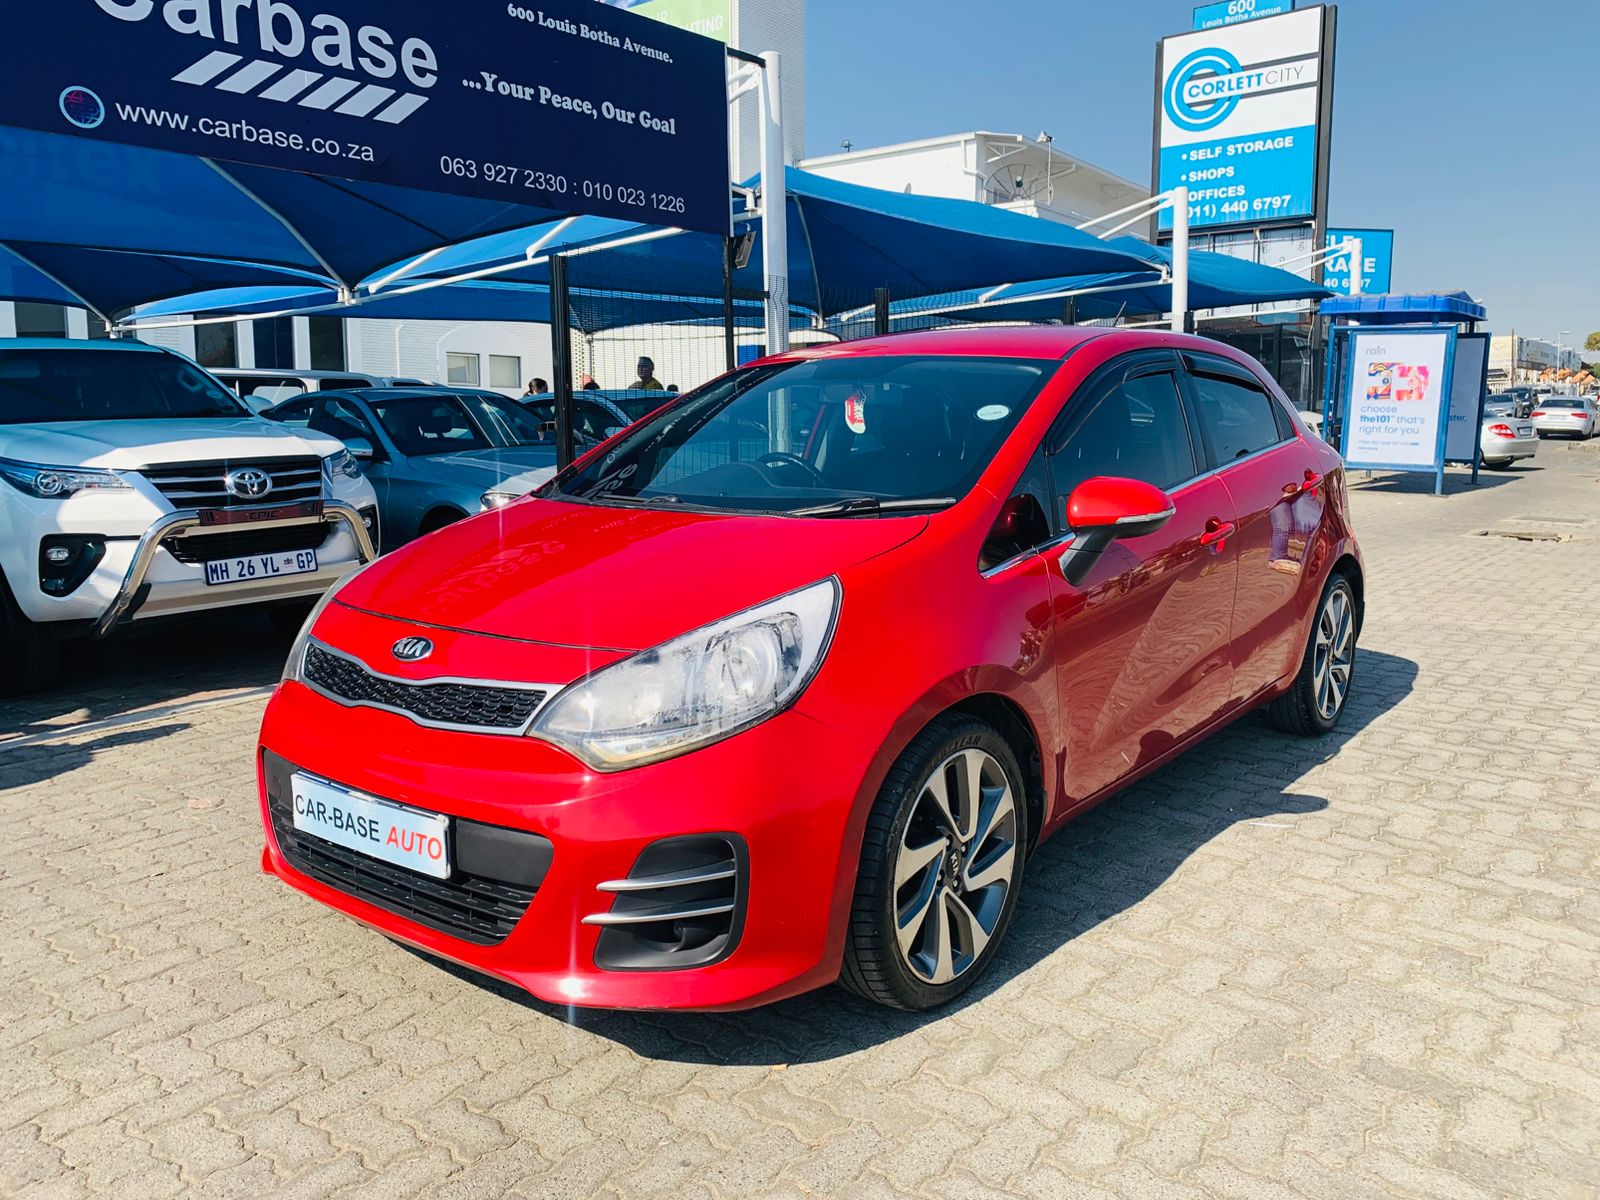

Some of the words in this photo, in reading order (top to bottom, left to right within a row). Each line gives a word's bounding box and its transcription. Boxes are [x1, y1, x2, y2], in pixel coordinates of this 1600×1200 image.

[1202, 18, 1223, 28] Louis
[1224, 13, 1248, 23] Botha
[1250, 6, 1282, 18] Avenue
[1227, 0, 1255, 15] 600
[94, 0, 438, 88] arbase
[507, 3, 535, 22] 600
[538, 11, 577, 35] Louis
[580, 24, 620, 48] Botha
[623, 37, 674, 63] Avenue.
[538, 85, 598, 119] Peace,
[602, 101, 636, 125] Our
[639, 110, 676, 135] Goal
[115, 102, 375, 162] www.carbase.co.za
[1189, 146, 1222, 161] SELF
[1226, 136, 1294, 156] STORAGE
[440, 155, 477, 179] 063
[484, 163, 518, 184] 927
[524, 170, 567, 193] 2330
[583, 180, 612, 200] 010
[617, 186, 646, 206] 023
[650, 193, 685, 213] 1226
[1188, 166, 1235, 182] SHOPS
[1188, 185, 1246, 202] OFFICES
[1221, 200, 1249, 214] 440
[1253, 195, 1291, 210] 6797
[1360, 405, 1398, 413] choose
[1397, 415, 1425, 424] that's
[1359, 425, 1381, 435] right
[1384, 425, 1399, 434] for
[1400, 426, 1420, 435] you
[209, 562, 229, 582] MH
[236, 559, 256, 578] 26
[260, 556, 280, 574] YL
[296, 551, 313, 569] GP
[393, 638, 426, 657] KIA
[294, 794, 380, 842] CAR-BASE
[386, 826, 443, 860] AUTO
